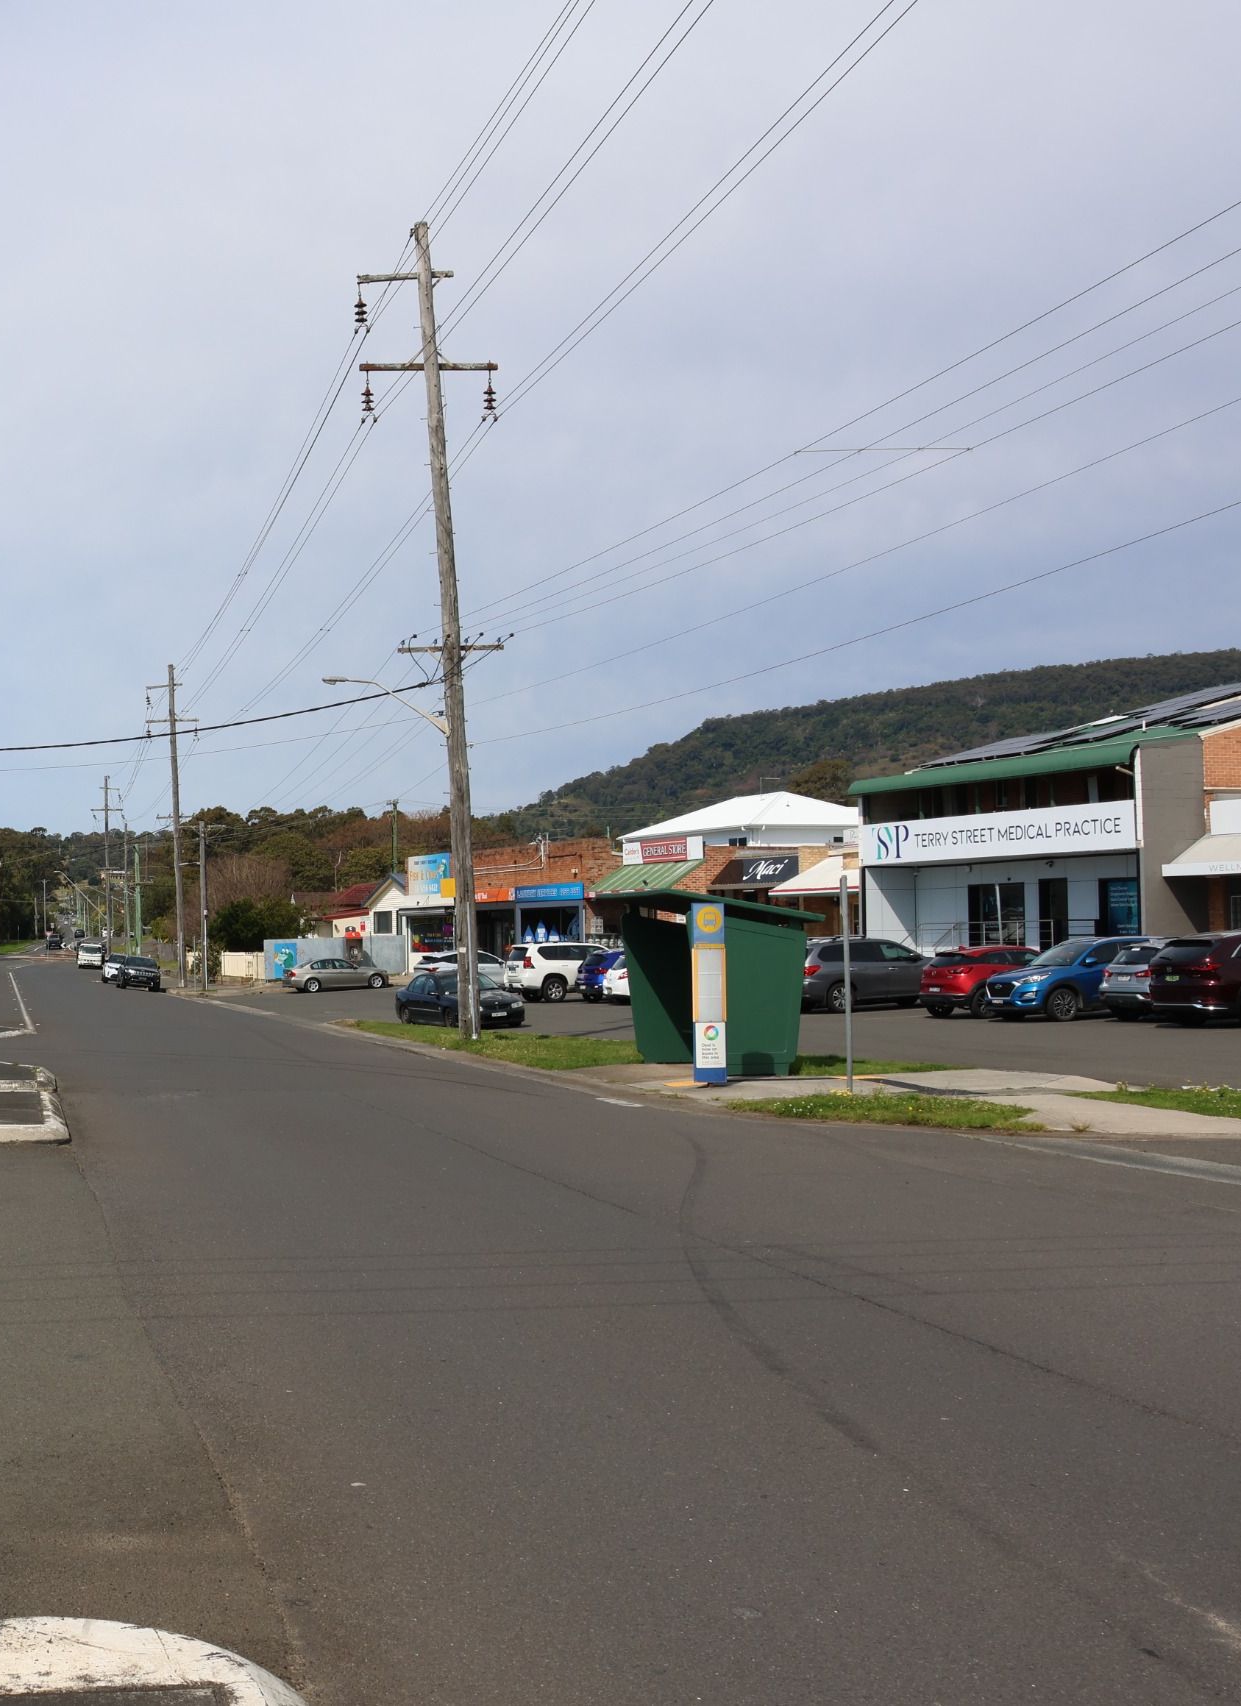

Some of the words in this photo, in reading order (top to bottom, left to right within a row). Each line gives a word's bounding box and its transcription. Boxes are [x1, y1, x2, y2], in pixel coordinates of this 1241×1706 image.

[914, 832, 949, 848] TERRY
[951, 827, 995, 845] STREET
[998, 822, 1052, 842] MEDICAL
[1055, 817, 1122, 838] PRACTICE
[643, 845, 667, 857] GENERAL
[669, 844, 687, 855] STORE
[743, 859, 789, 880] Maci
